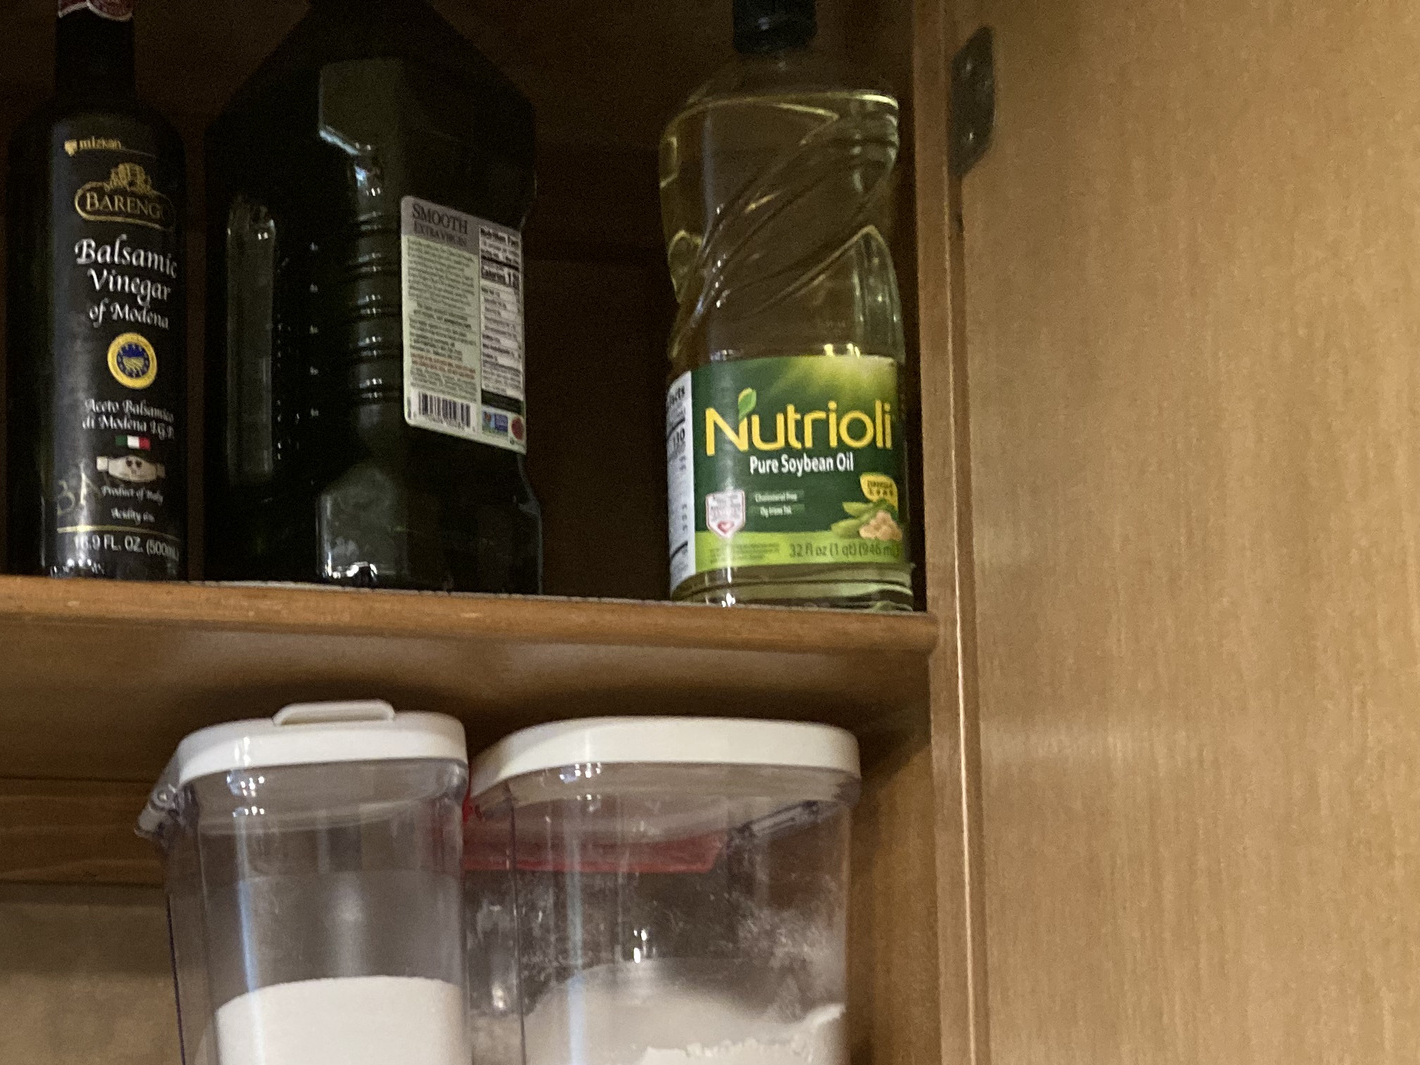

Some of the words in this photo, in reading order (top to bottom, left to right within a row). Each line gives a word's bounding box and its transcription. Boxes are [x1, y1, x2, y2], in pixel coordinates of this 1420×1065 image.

[412, 202, 469, 235] SMOOTH
[74, 233, 178, 279] Balsamic
[86, 267, 171, 308] Vinegar
[89, 298, 110, 328] of
[110, 301, 170, 330] Modena
[84, 398, 121, 414] Aceto
[97, 414, 148, 433] Modena
[704, 400, 893, 457] Nutrioli
[749, 455, 779, 475] Pure
[780, 453, 834, 477] Soybean
[837, 452, 854, 471] Oil
[789, 543, 803, 558] 32
[815, 547, 828, 556] oz
